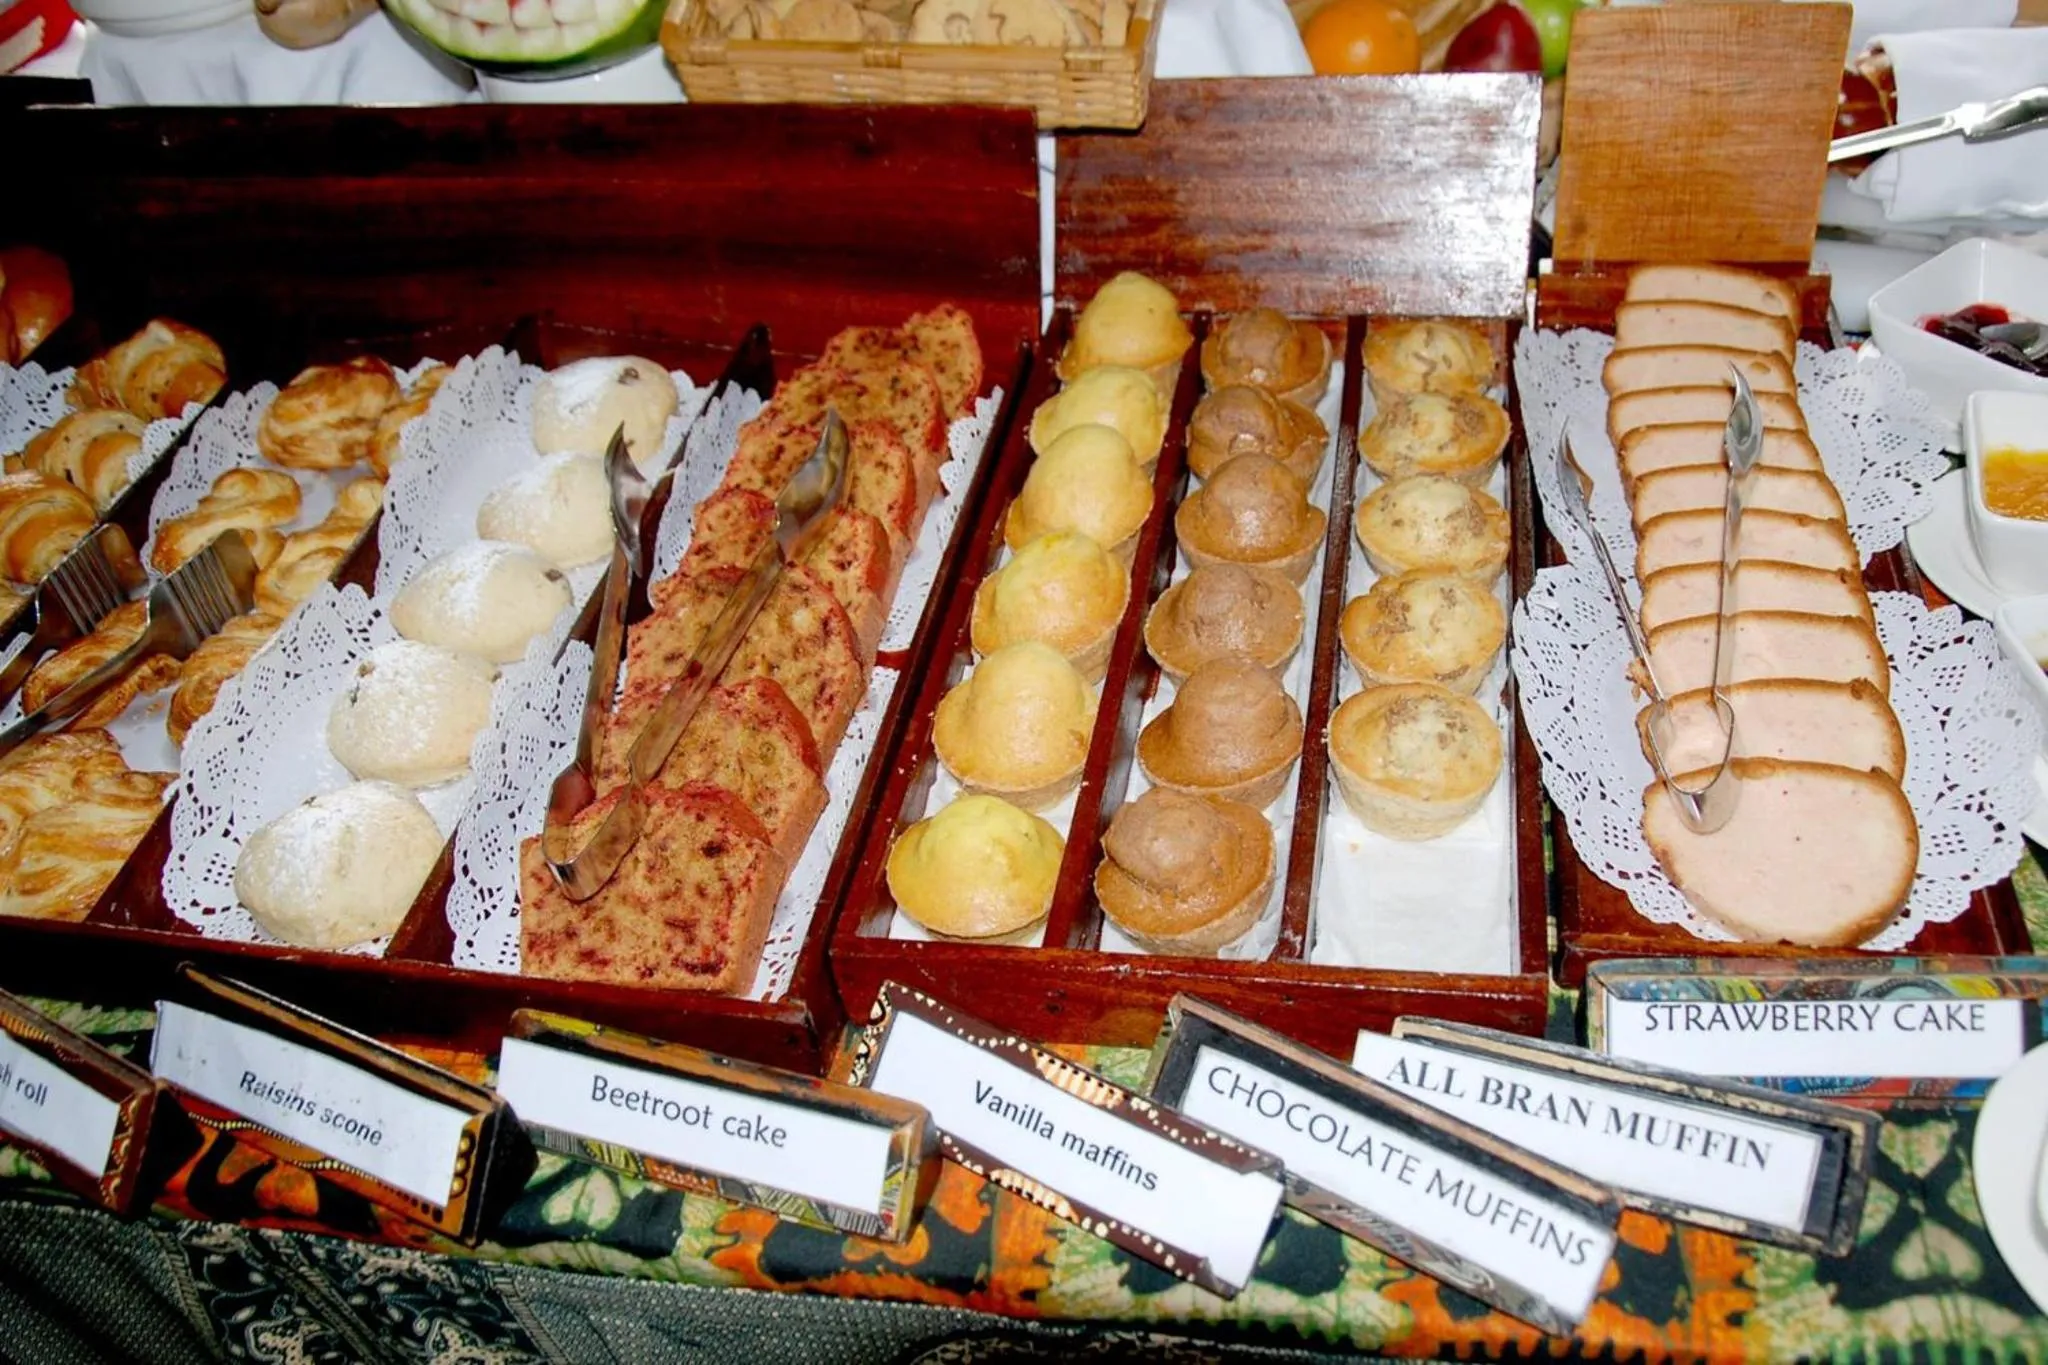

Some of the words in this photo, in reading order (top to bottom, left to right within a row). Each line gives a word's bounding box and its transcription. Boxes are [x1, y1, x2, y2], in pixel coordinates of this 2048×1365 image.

[1645, 1003, 1880, 1032] STRAWBERRY
[1893, 1003, 1986, 1032] CAKE
[16, 1078, 48, 1106] roll
[240, 1071, 316, 1116] Raisins
[320, 1107, 382, 1146] scone
[591, 1075, 714, 1129] Beetroot
[722, 1114, 787, 1148] cake
[1386, 1056, 1466, 1098] ALL
[1479, 1077, 1595, 1128] BRAN
[1602, 1107, 1773, 1172] MUFFIN
[973, 1080, 1055, 1140] Vanilla
[1061, 1130, 1159, 1191] maffins
[1208, 1066, 1421, 1185] CHOCOLATE
[1425, 1168, 1596, 1266] MUFFINS
